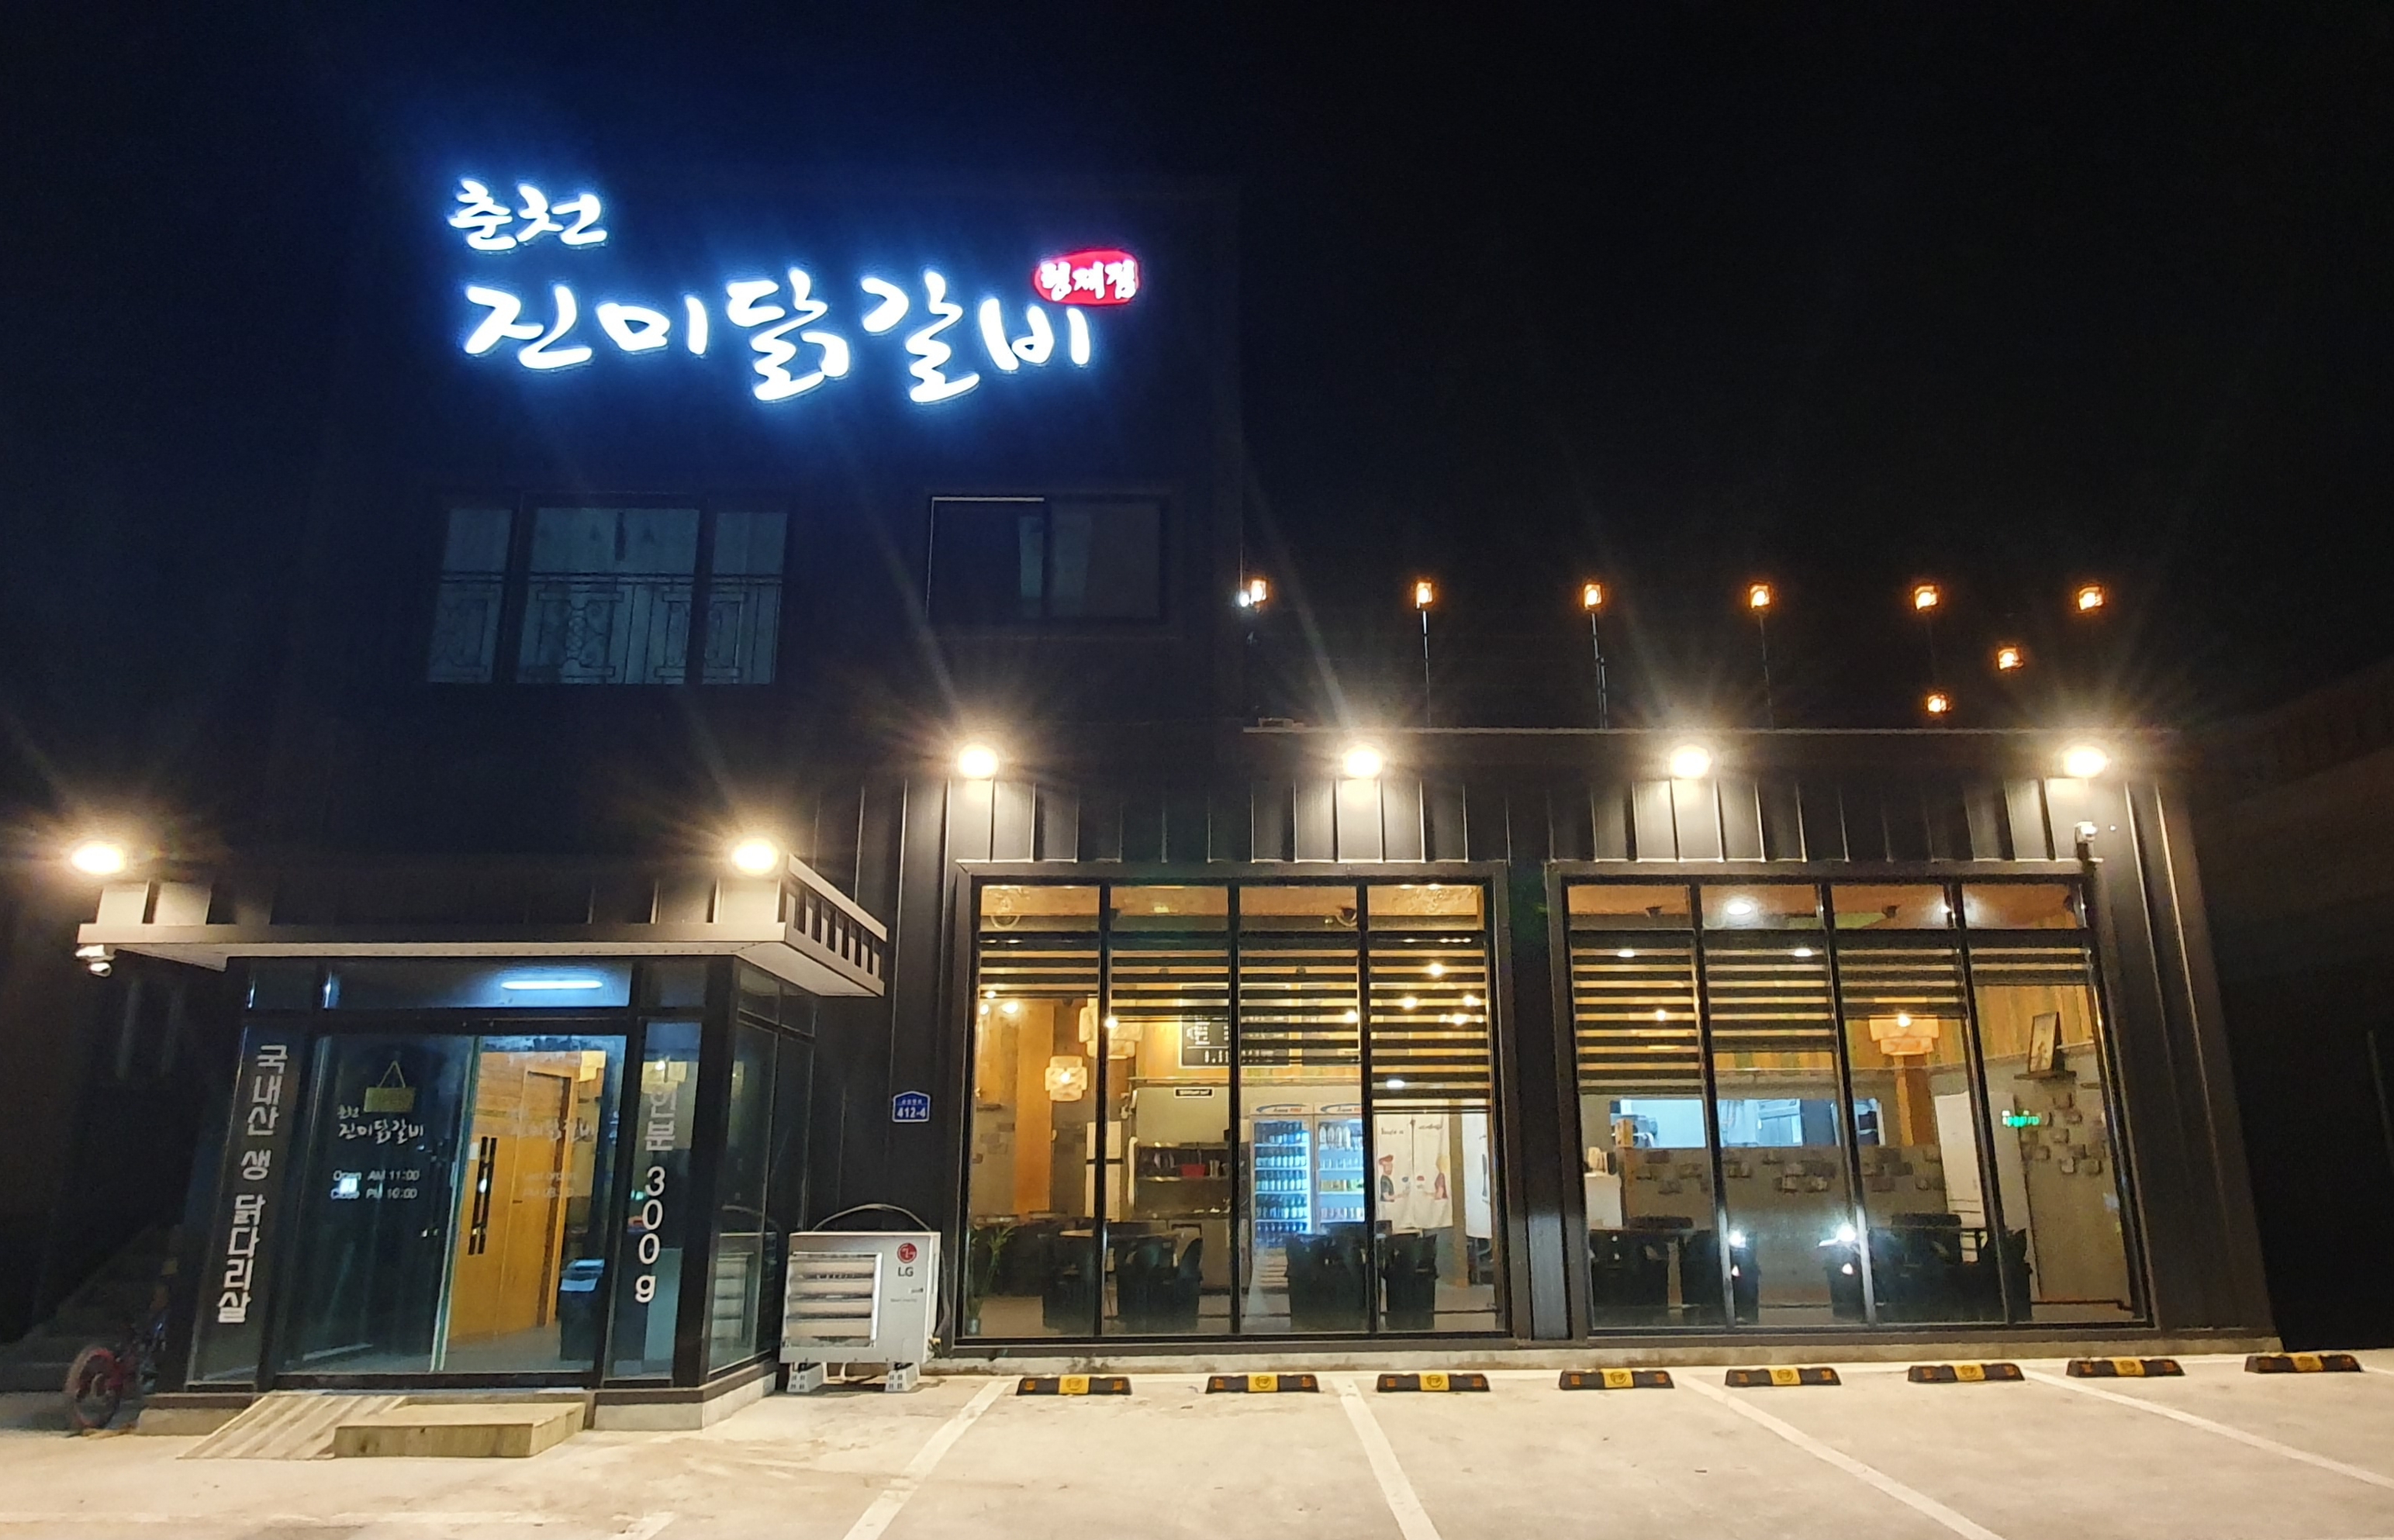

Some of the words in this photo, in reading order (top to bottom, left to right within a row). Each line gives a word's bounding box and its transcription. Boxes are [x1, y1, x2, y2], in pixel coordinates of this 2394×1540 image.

[447, 179, 608, 251] 춘천
[464, 268, 1090, 402] 진미닭갈비
[247, 1045, 288, 1136] 국내산
[896, 1107, 926, 1118] 412-4
[241, 1149, 271, 1180] 생
[218, 1194, 265, 1324] 닭다리살
[898, 1266, 914, 1277] LG
